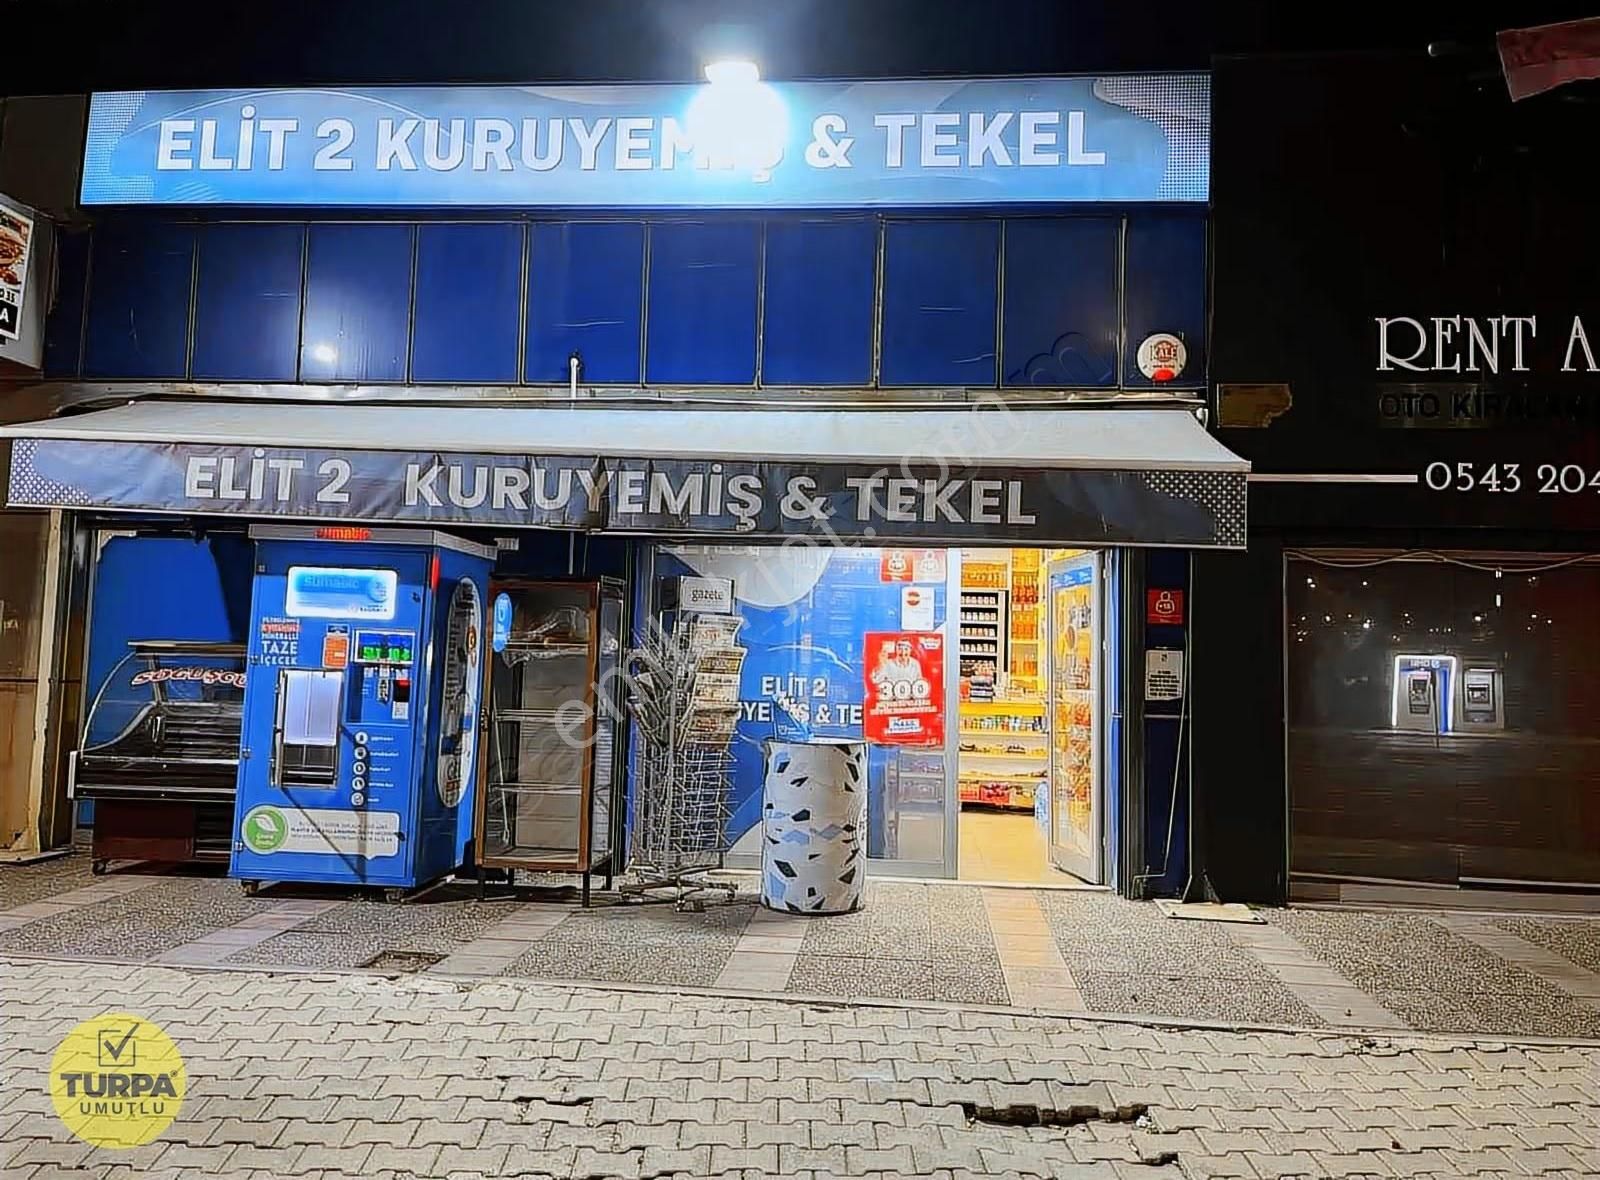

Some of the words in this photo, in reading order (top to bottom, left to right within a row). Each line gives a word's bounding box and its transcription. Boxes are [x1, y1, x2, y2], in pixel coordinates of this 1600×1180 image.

[157, 104, 298, 171] ELİT
[315, 118, 355, 171] 2
[376, 114, 784, 182] KURUYEMŞ
[805, 115, 856, 168] &
[875, 111, 1107, 168] TEKEL
[1375, 315, 1536, 374] RENT
[1561, 316, 1600, 372] A
[185, 449, 304, 500] ELİT
[317, 458, 351, 502] 2
[404, 463, 763, 531] KURUYEMİŞ
[780, 476, 829, 521] &
[847, 477, 1036, 525] TEKEL
[1425, 462, 1521, 493] 0543
[261, 640, 298, 655] TAZE
[762, 672, 807, 697] ELİT
[812, 677, 828, 697] 2
[880, 680, 930, 700] 300
[816, 703, 832, 724] &
